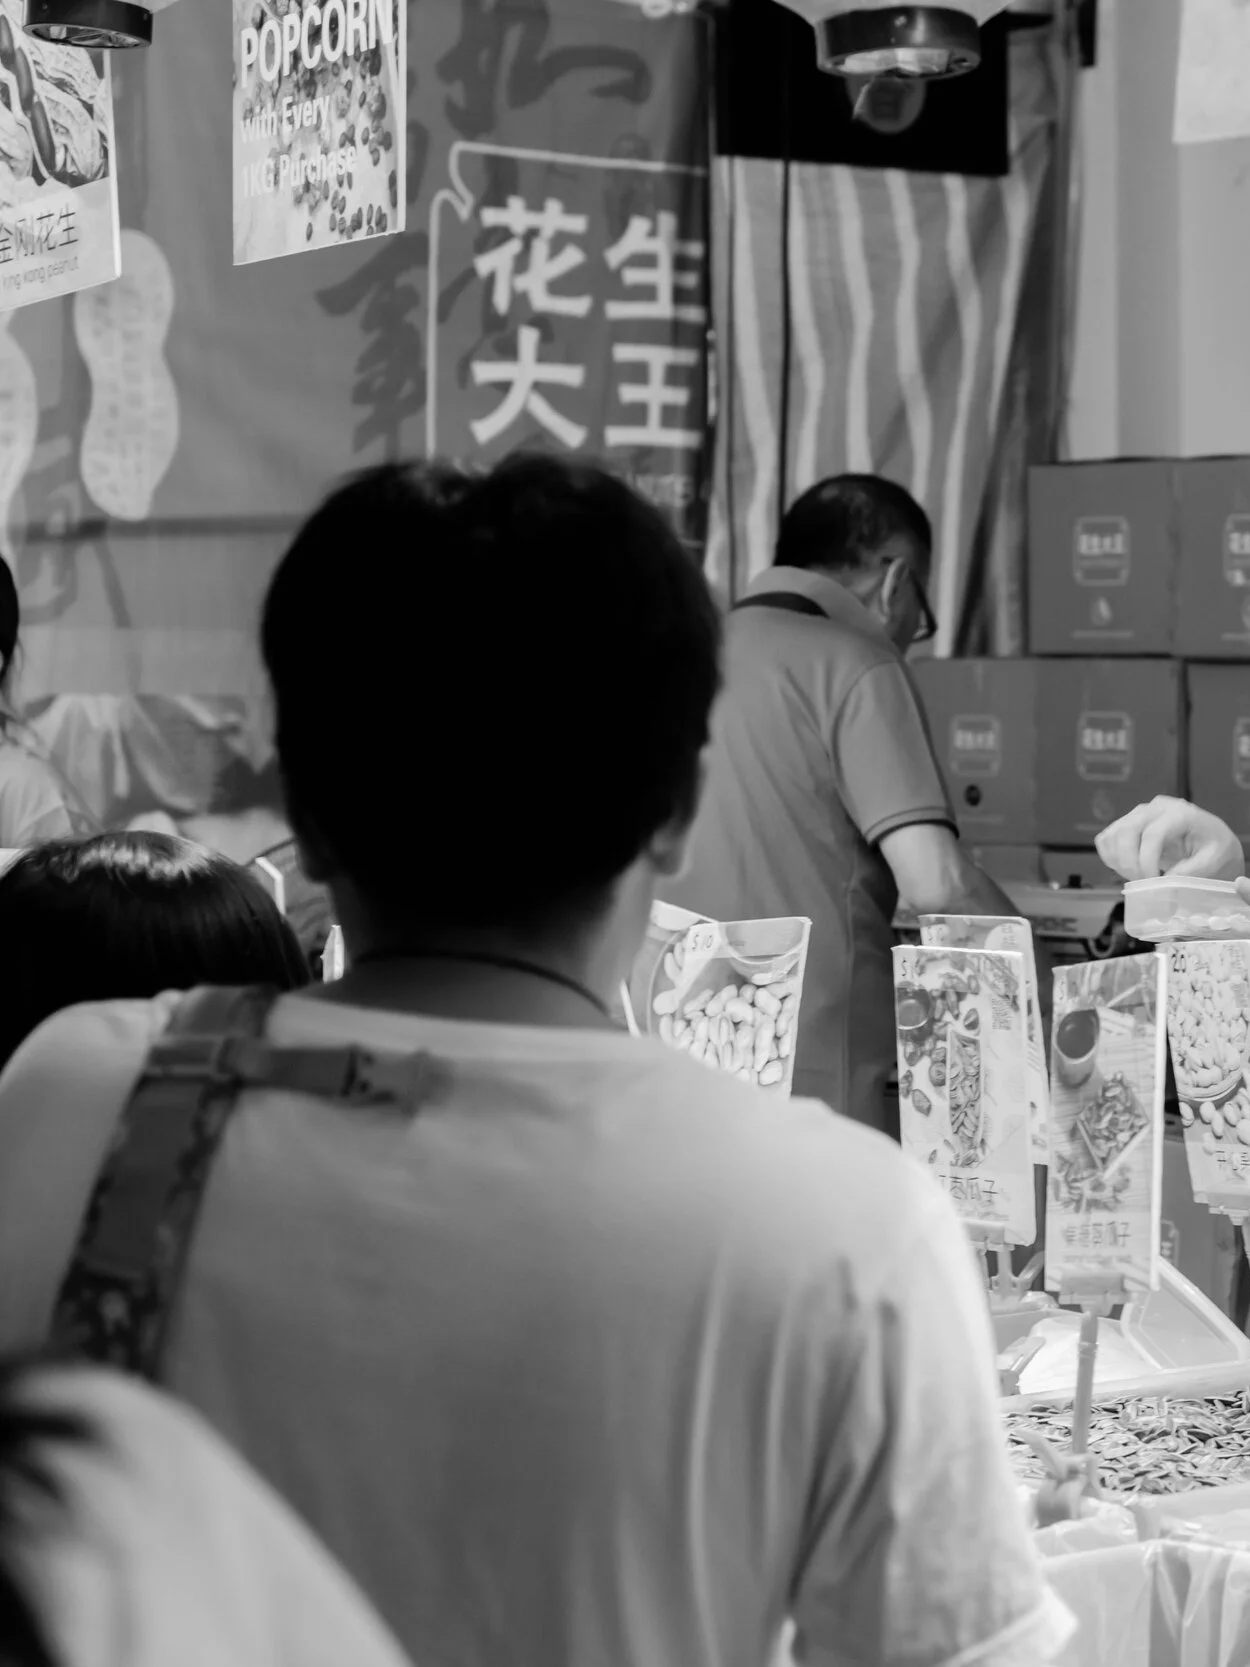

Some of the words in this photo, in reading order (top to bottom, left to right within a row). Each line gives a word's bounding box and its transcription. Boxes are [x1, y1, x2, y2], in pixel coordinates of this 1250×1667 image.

[240, 0, 393, 89] POPCORN
[282, 95, 330, 146] Every
[279, 146, 357, 189] Purchase
[473, 195, 706, 321] 花生
[469, 325, 703, 450] 大王
